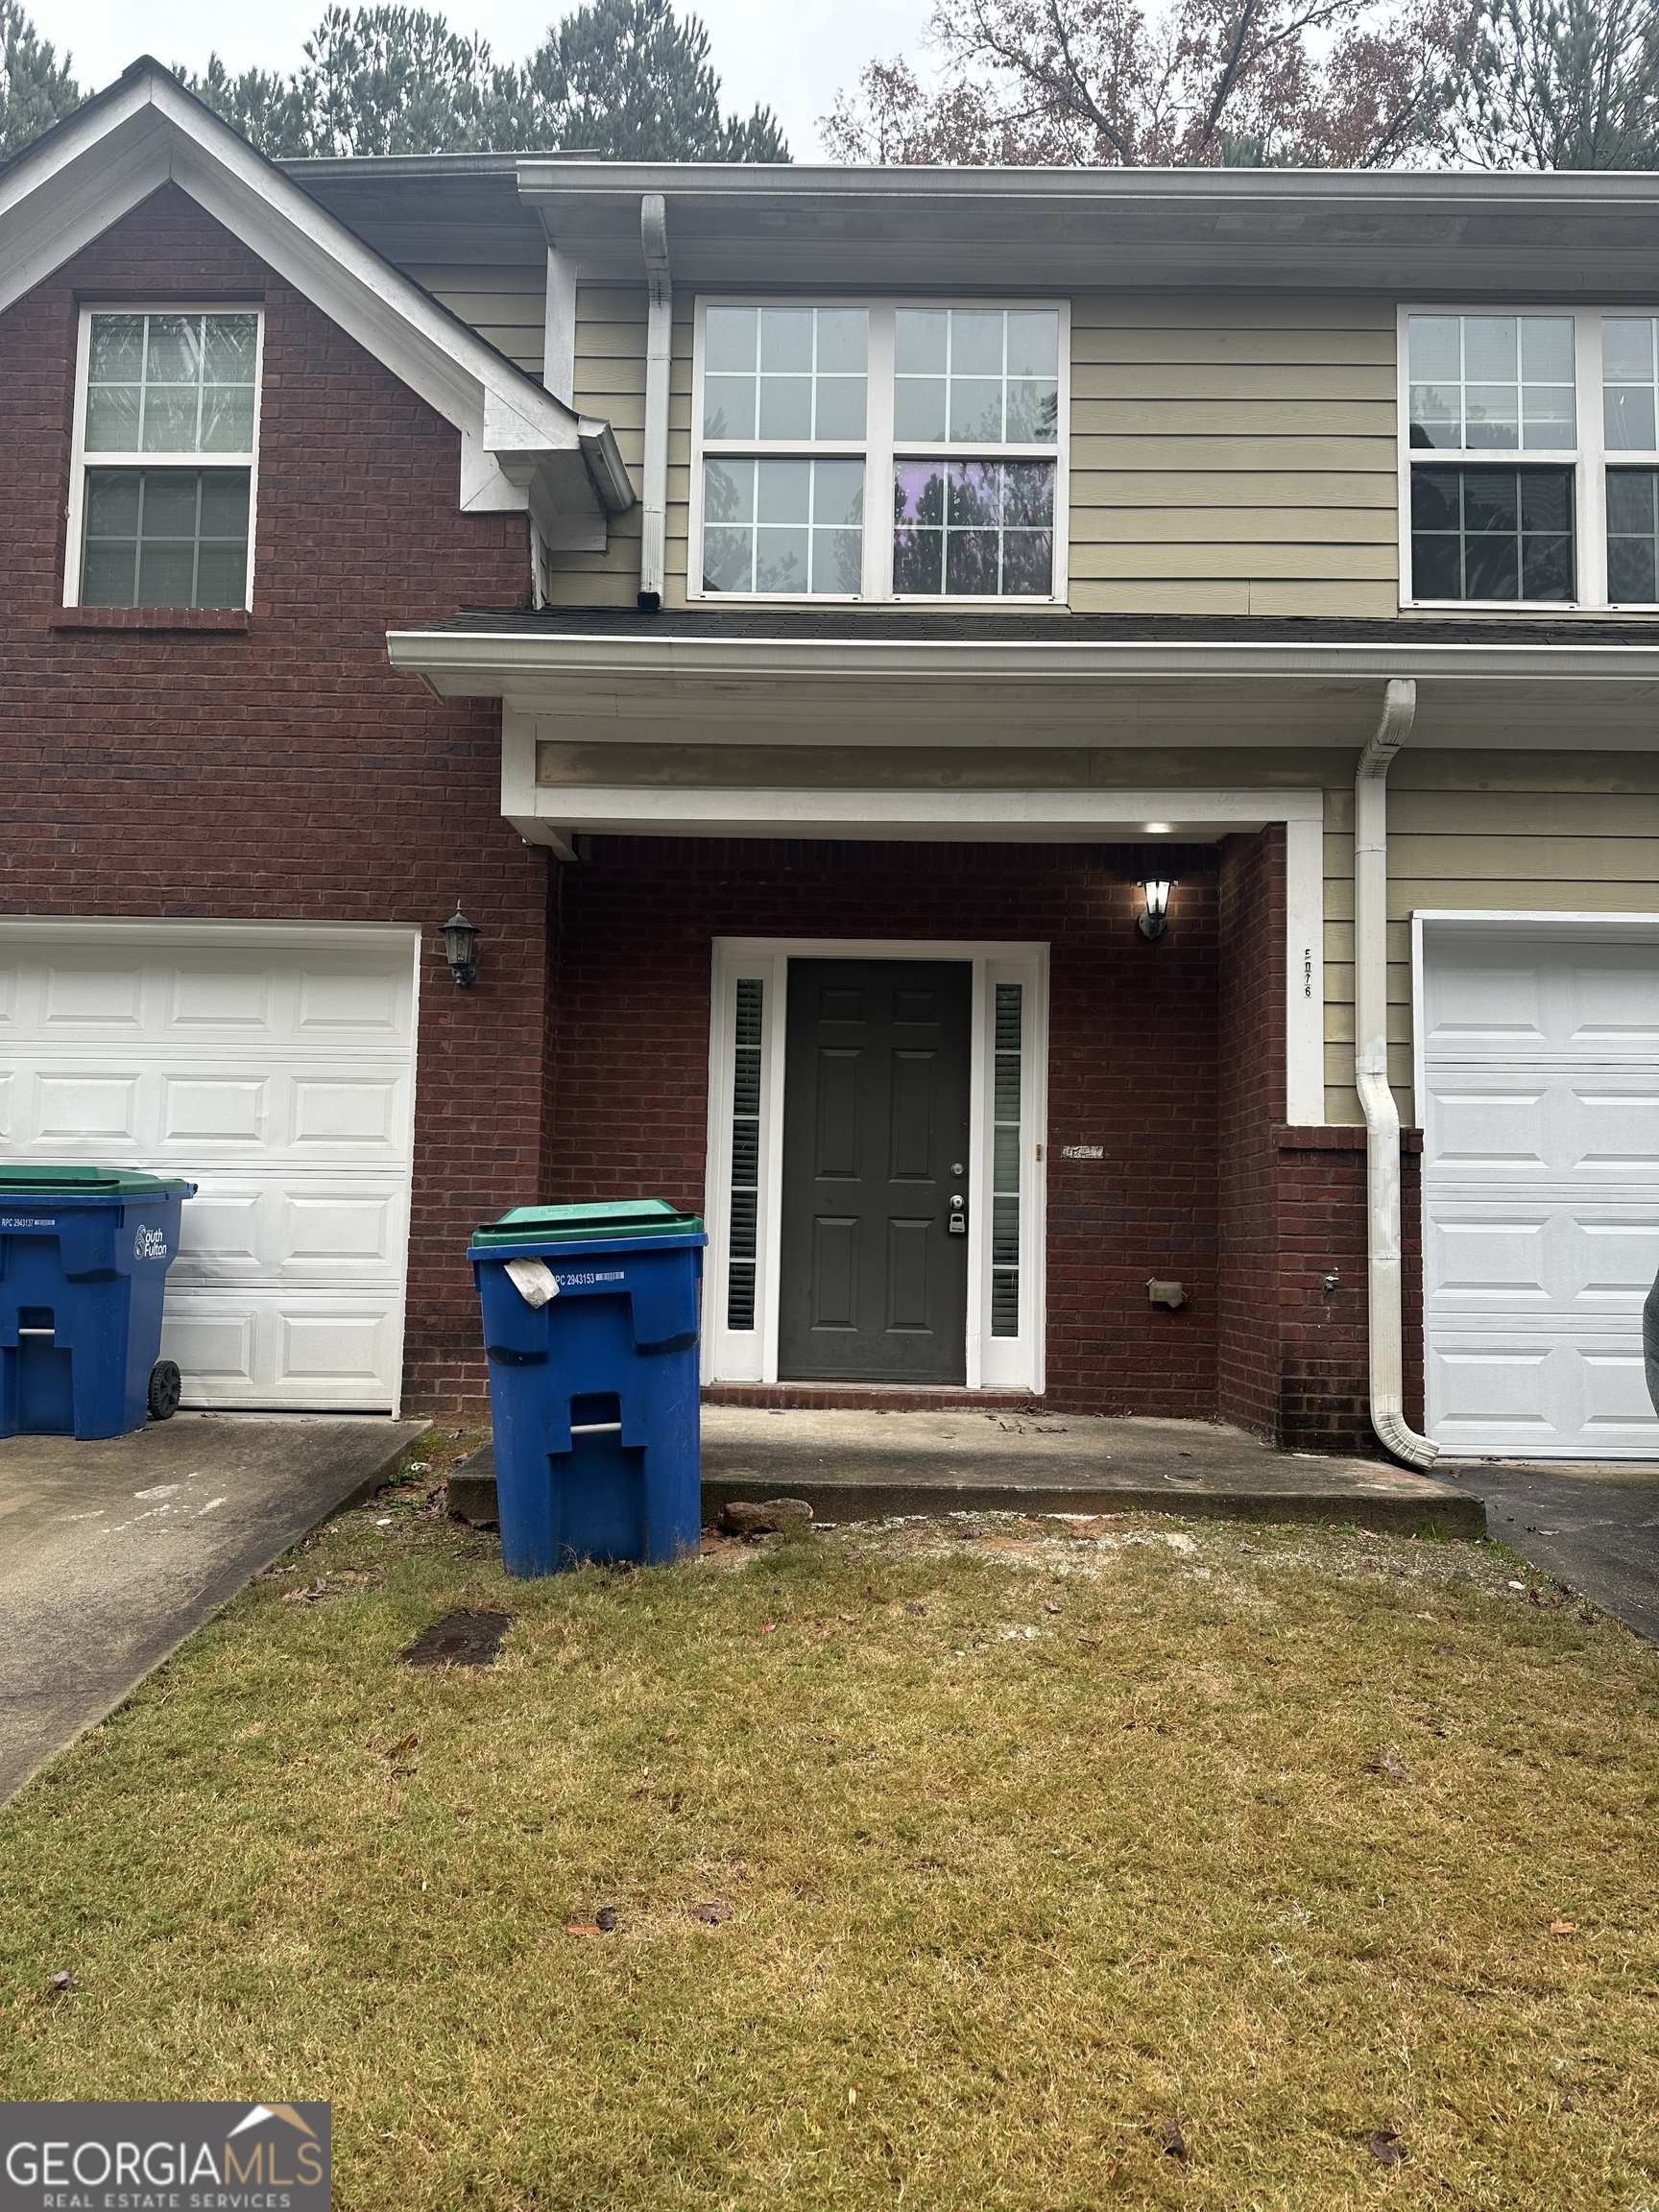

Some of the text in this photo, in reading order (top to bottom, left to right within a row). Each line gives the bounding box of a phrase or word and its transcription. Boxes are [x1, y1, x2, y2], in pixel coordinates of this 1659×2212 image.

[1, 1217, 35, 1227] RPC 2943137
[144, 1241, 167, 1257] Fulton
[554, 1273, 595, 1286] PC 2943153
